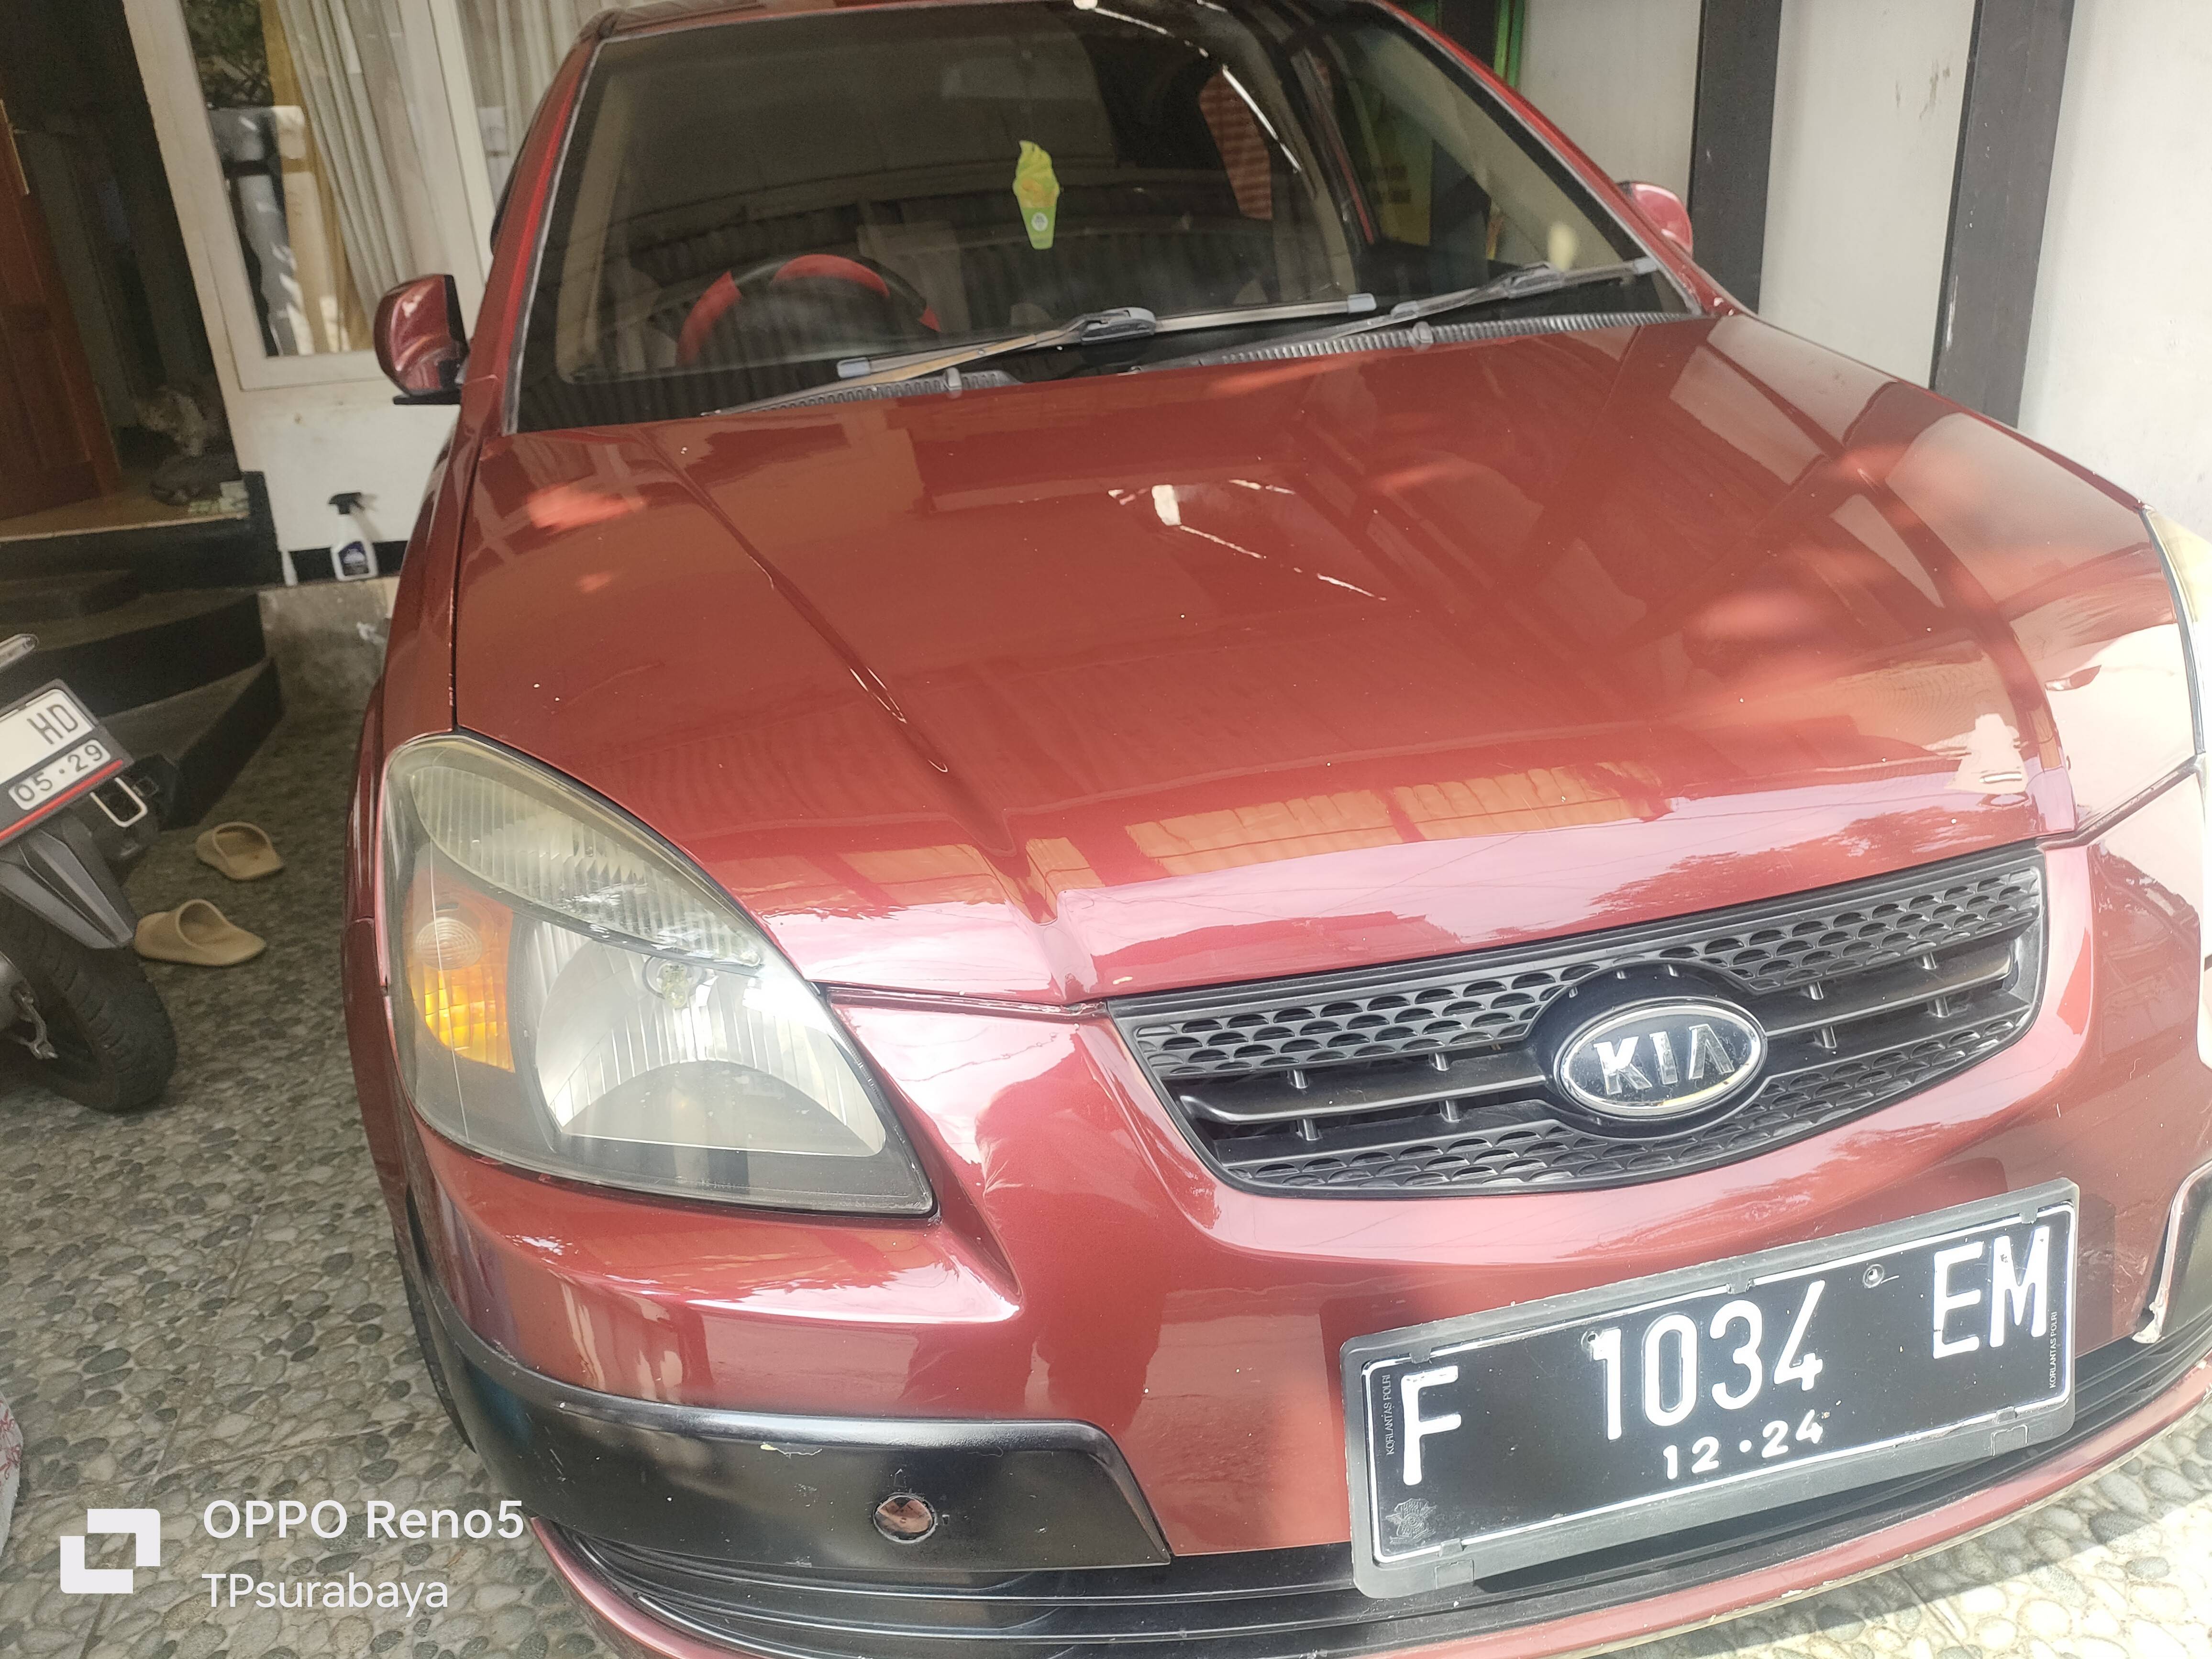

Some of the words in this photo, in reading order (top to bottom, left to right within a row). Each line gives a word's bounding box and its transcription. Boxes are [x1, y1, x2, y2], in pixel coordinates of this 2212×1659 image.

[26, 704, 79, 745] HD
[1593, 1023, 1735, 1095] KIA
[1401, 1365, 1461, 1486] F
[1592, 1280, 1825, 1440] 1034
[1933, 1226, 2050, 1359] EM
[1382, 1402, 1395, 1455] KORLANTAS
